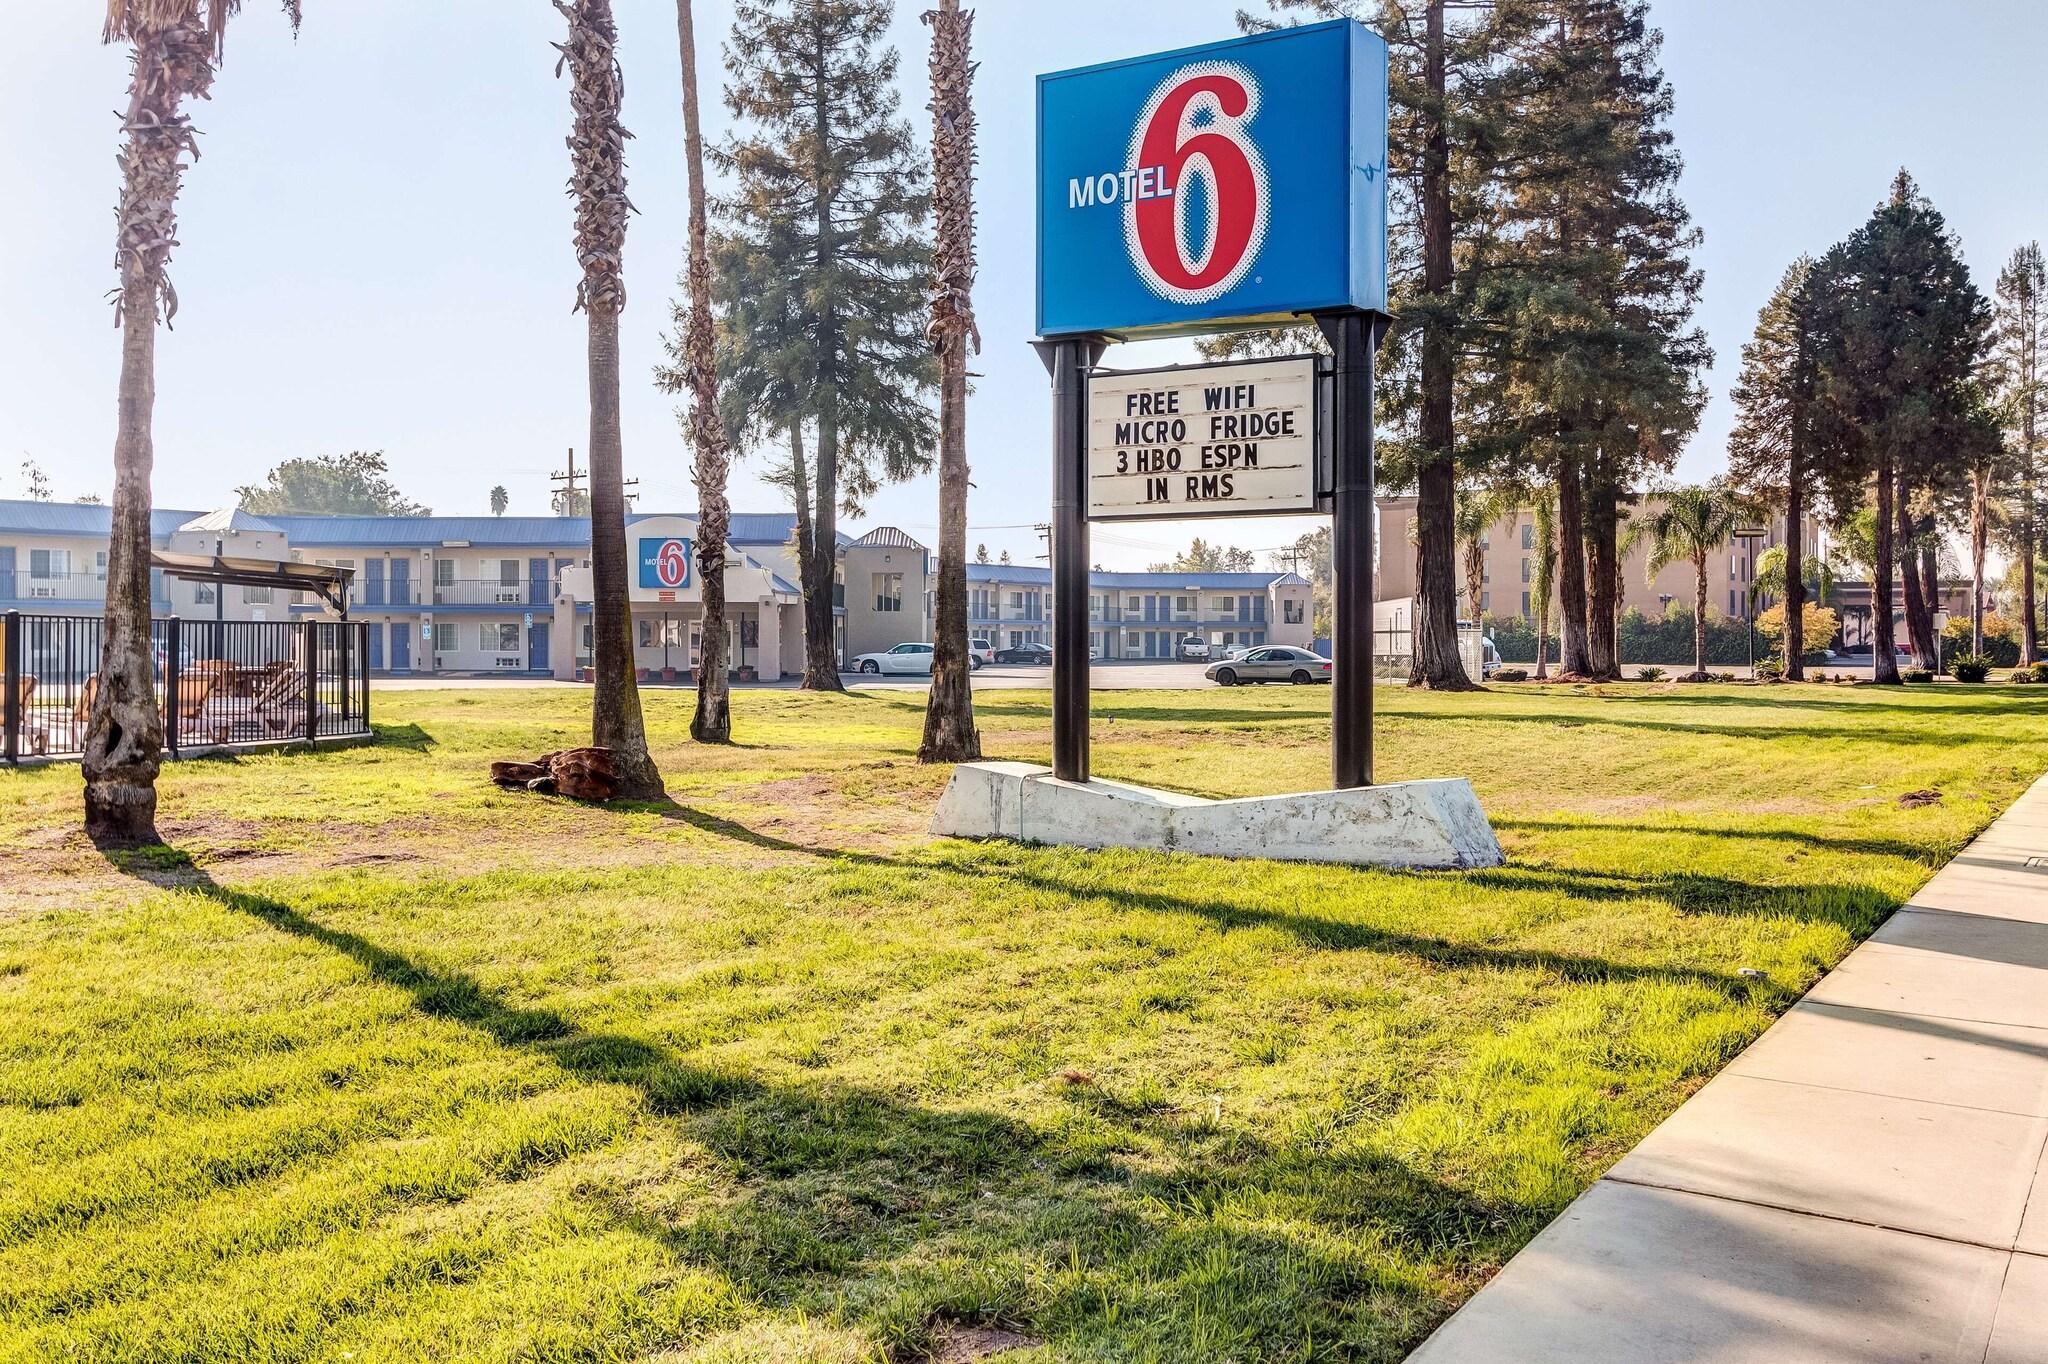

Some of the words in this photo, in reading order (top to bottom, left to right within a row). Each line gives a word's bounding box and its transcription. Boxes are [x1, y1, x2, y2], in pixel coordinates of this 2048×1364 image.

[1068, 164, 1173, 209] MOTEL
[1133, 72, 1259, 293] 6
[1126, 390, 1180, 417] FREE
[1203, 384, 1255, 411] WIFI
[1115, 418, 1187, 446] MICRO
[1210, 411, 1294, 439] FRIDGE
[1116, 450, 1129, 473] 3
[1136, 447, 1182, 472] HBO
[1201, 443, 1258, 469] ESPN
[1146, 477, 1168, 501] IN
[1186, 473, 1234, 500] RMS
[658, 541, 686, 586] 6
